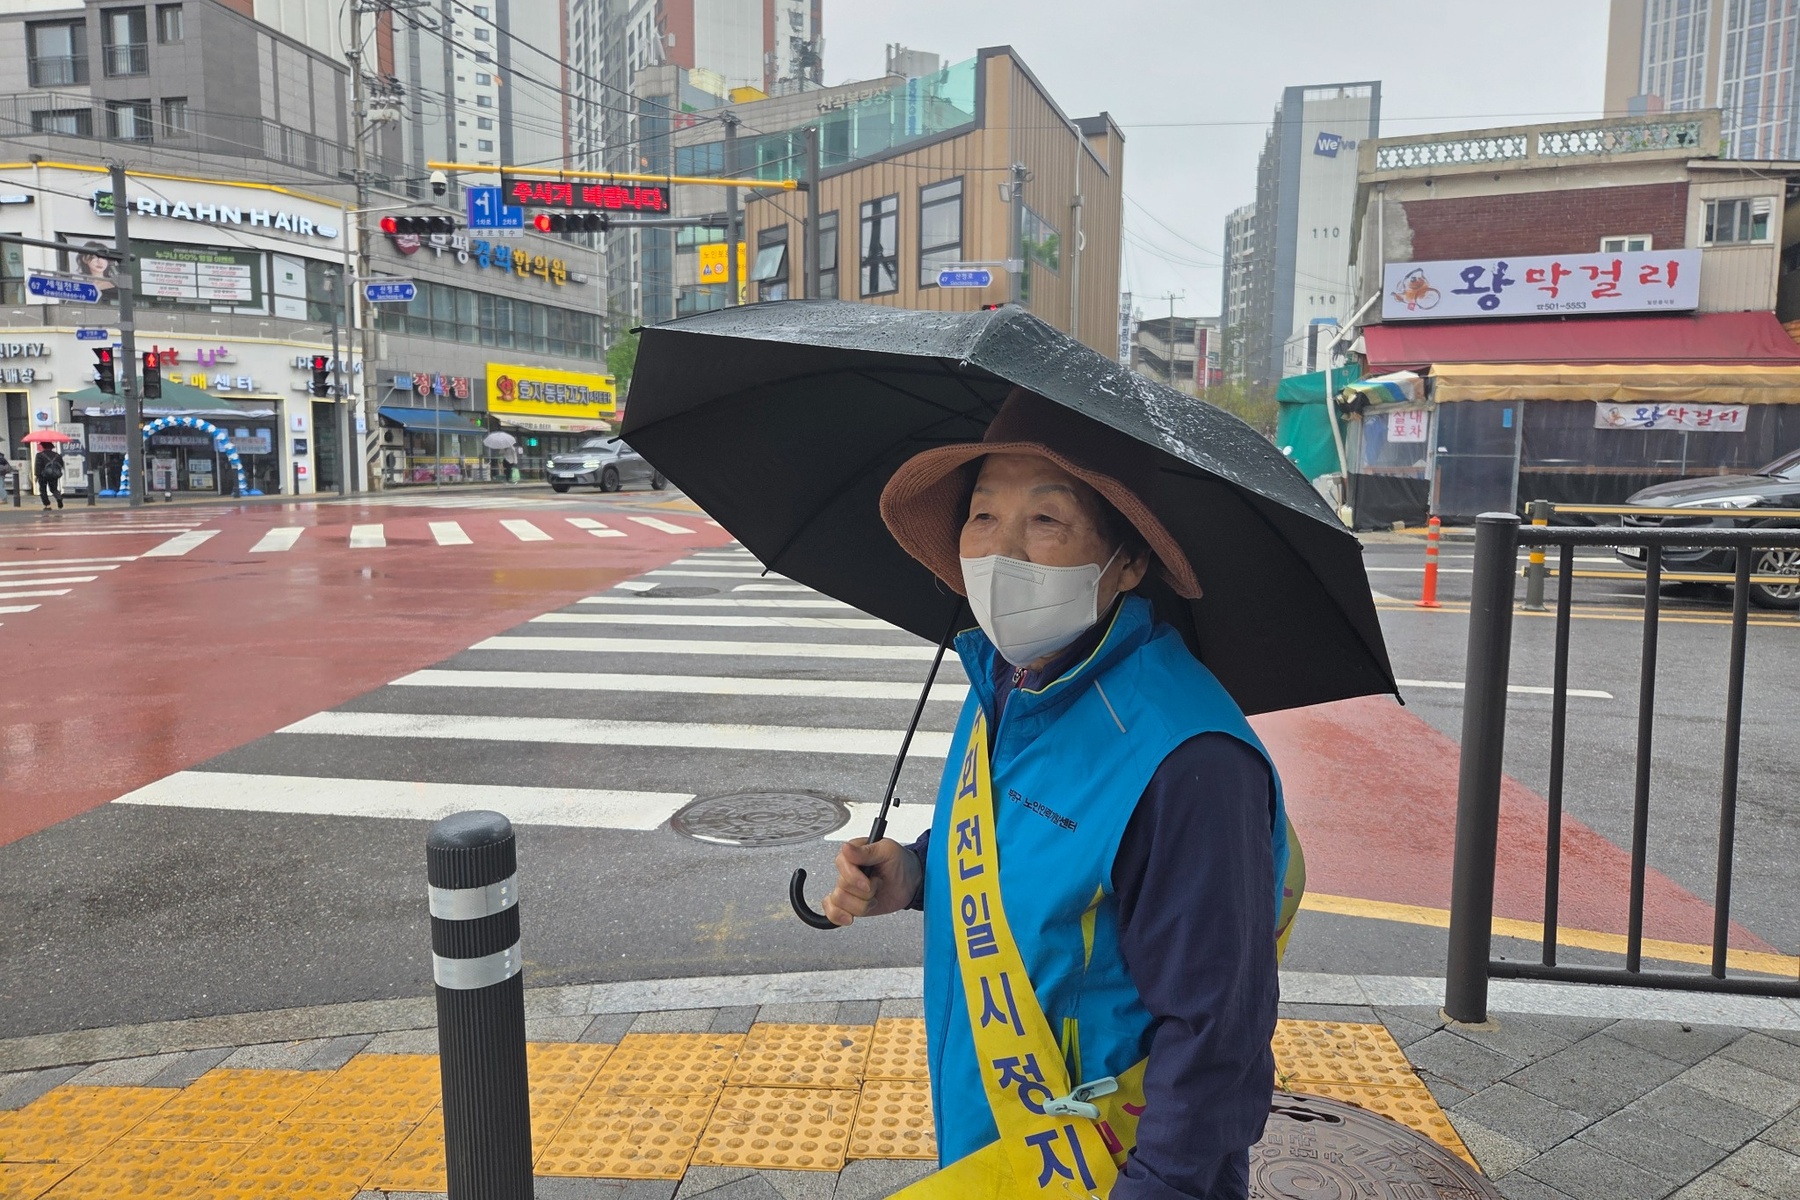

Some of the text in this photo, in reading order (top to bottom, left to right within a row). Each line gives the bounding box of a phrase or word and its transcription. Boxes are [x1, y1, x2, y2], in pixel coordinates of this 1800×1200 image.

[1318, 137, 1356, 151] We've
[512, 181, 573, 206] 주시기
[136, 197, 315, 237] RIAHN HAIR
[476, 218, 492, 226] 1차로
[502, 218, 518, 226] 2차로
[1311, 227, 1340, 239] 110
[31, 280, 96, 298] 67 세월천로 71
[1450, 260, 1680, 311] 왕막걸리
[1308, 295, 1336, 305] 110
[1545, 301, 1586, 310] 501-5553
[296, 356, 364, 375] PRMUM
[0, 368, 35, 384] 매장
[1393, 409, 1422, 424] 실내
[1631, 403, 1739, 428] 왕막걸리
[1393, 424, 1422, 438] 포차
[1008, 788, 1078, 833] 부평구 노인인력개발센터
